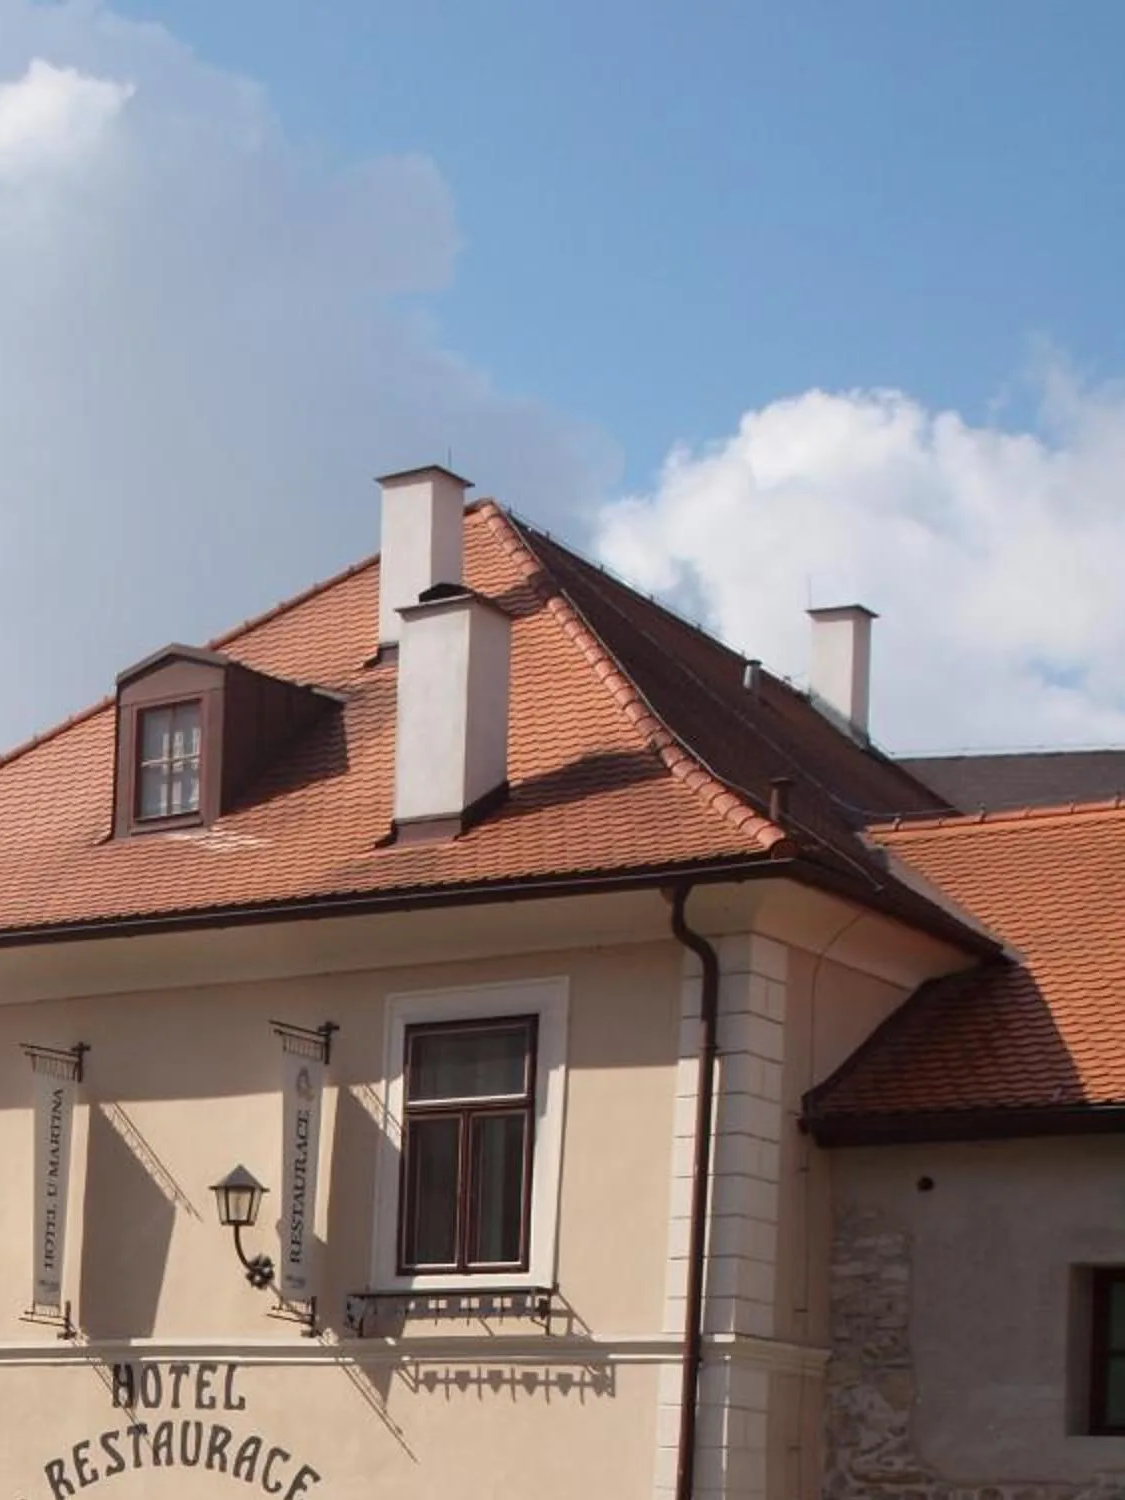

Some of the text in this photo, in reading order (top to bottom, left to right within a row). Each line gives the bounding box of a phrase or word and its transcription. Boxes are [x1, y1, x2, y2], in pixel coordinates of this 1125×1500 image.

[48, 1088, 63, 1177] MARTINA
[289, 1109, 311, 1264] RESTAURACE
[112, 1362, 246, 1410] HOTEL
